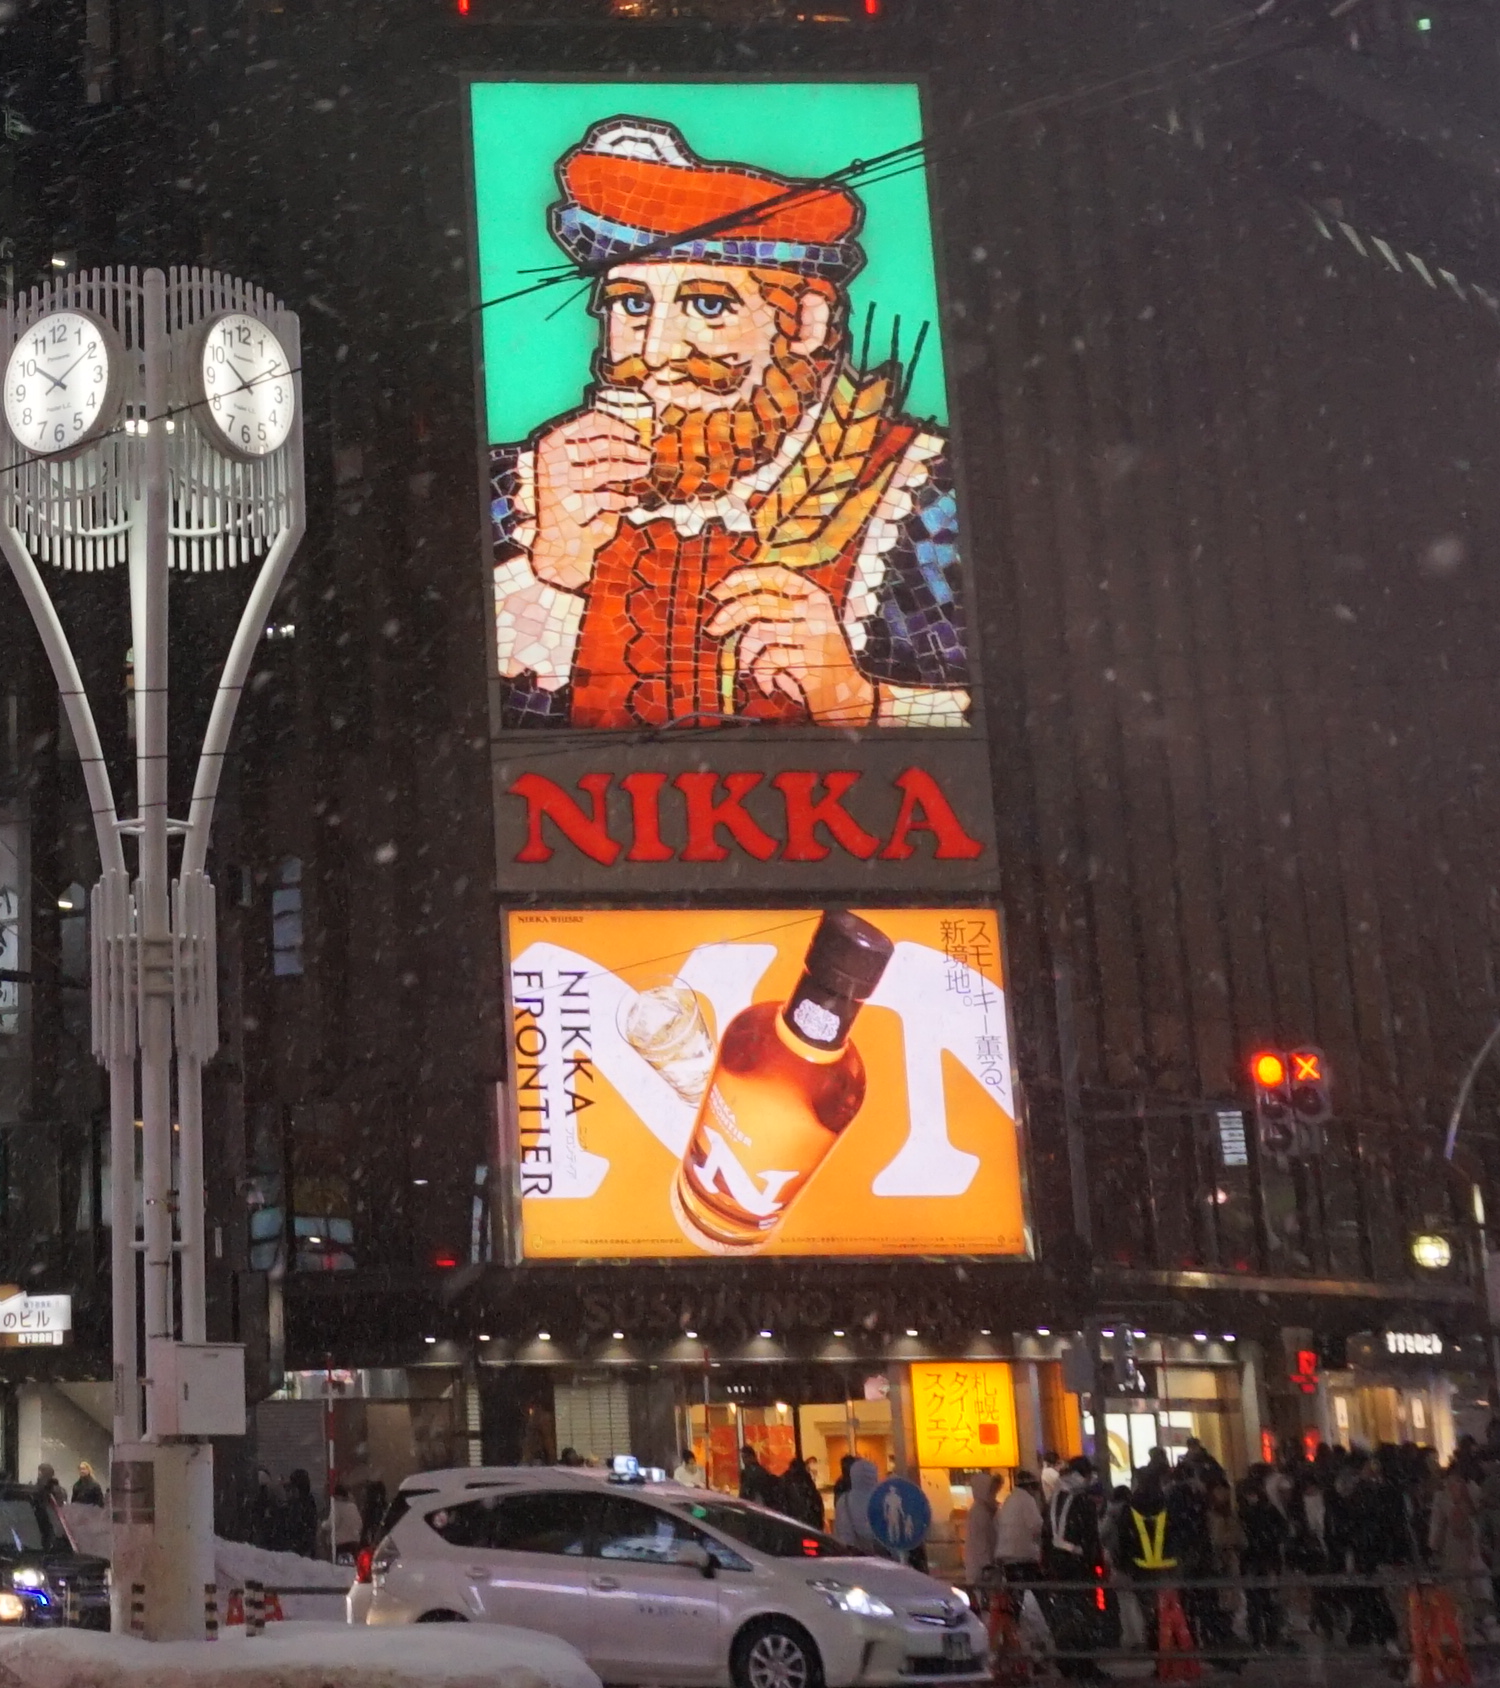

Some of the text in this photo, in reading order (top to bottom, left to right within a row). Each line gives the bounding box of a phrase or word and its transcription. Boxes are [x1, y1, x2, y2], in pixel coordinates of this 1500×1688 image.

[50, 324, 67, 344] 12
[74, 328, 82, 346] 1
[32, 338, 47, 356] 11
[19, 358, 37, 377] 10
[93, 364, 104, 383] 3
[15, 384, 26, 403] 9
[86, 390, 97, 409] 4
[22, 407, 33, 425] 8
[72, 412, 84, 431] 5
[38, 420, 48, 441] 7
[54, 424, 65, 443] 6
[507, 766, 985, 867] NIKKA
[518, 915, 549, 924] NIKKA
[939, 917, 974, 1008] 新境地。
[965, 919, 1007, 1097] スモーキー薫る、
[558, 968, 596, 1118] NIKKA
[512, 968, 554, 1199] FRONTIER
[973, 1371, 1000, 1424] 札幌
[923, 1372, 949, 1457] スクエア
[950, 1371, 978, 1454] タイムズ
